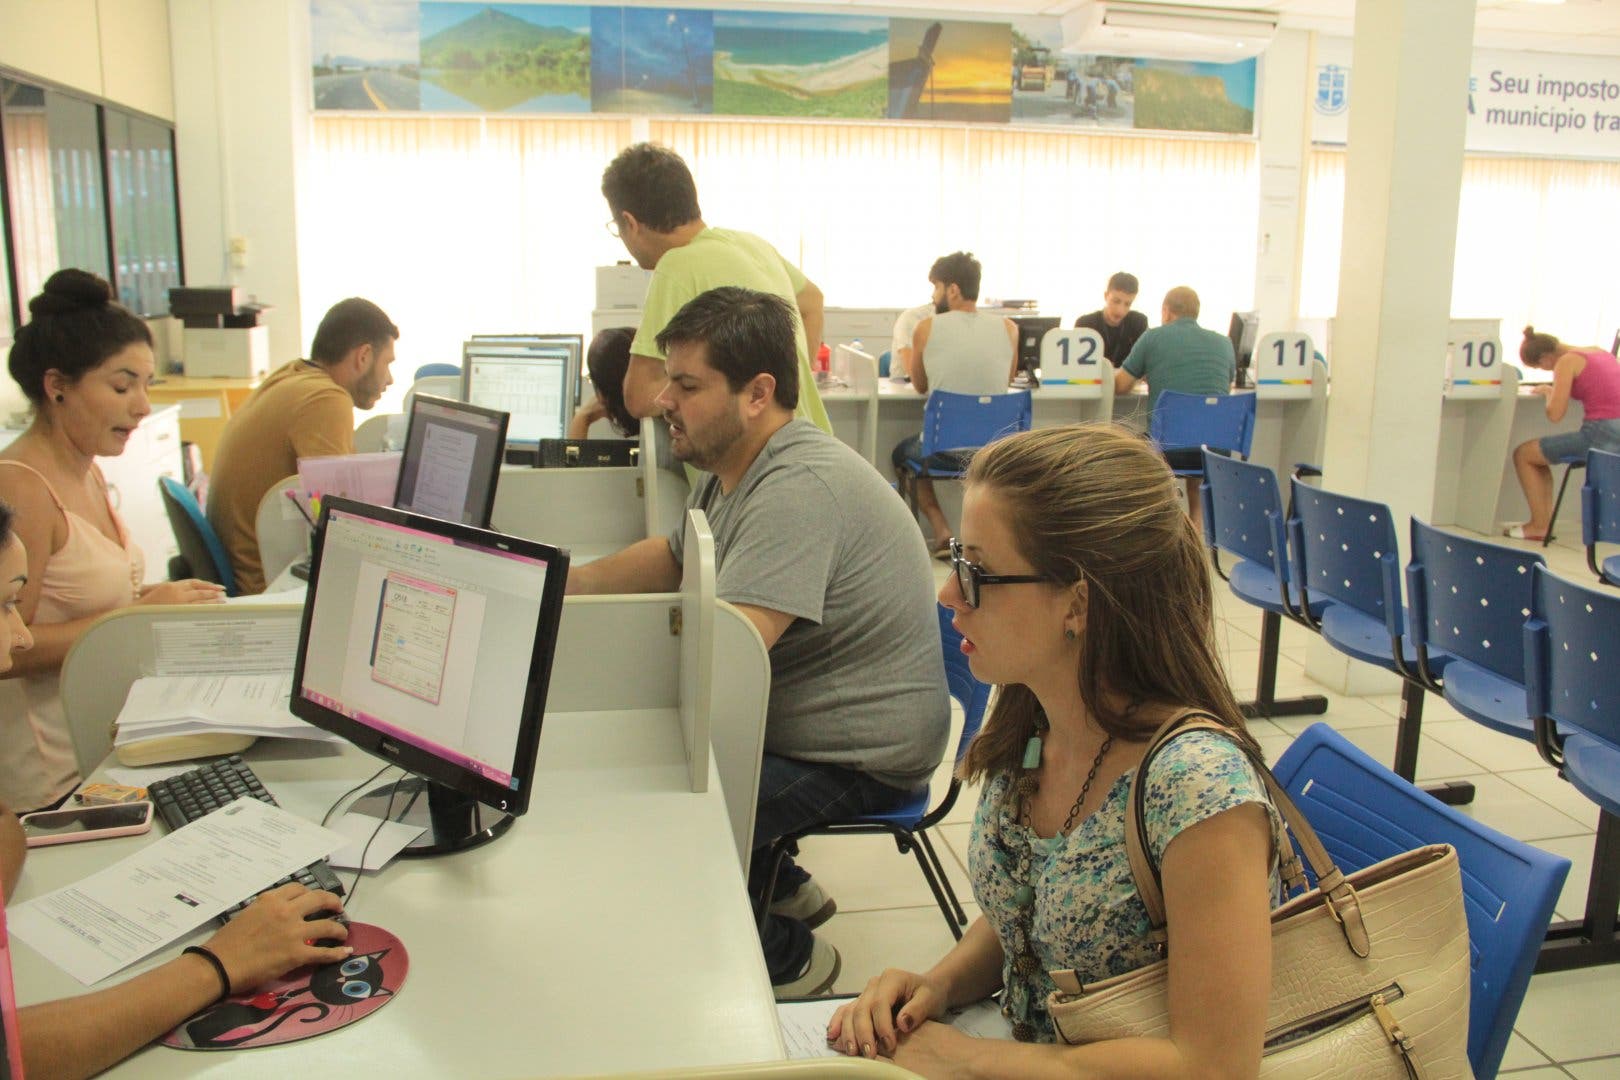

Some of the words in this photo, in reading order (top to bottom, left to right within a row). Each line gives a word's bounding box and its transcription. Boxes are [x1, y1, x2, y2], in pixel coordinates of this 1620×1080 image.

[1489, 70, 1530, 94] Seu
[1536, 73, 1620, 102] imposto
[1486, 105, 1587, 133] município
[1056, 336, 1098, 366] 12
[1272, 339, 1309, 367] 11
[1462, 340, 1496, 368] 10
